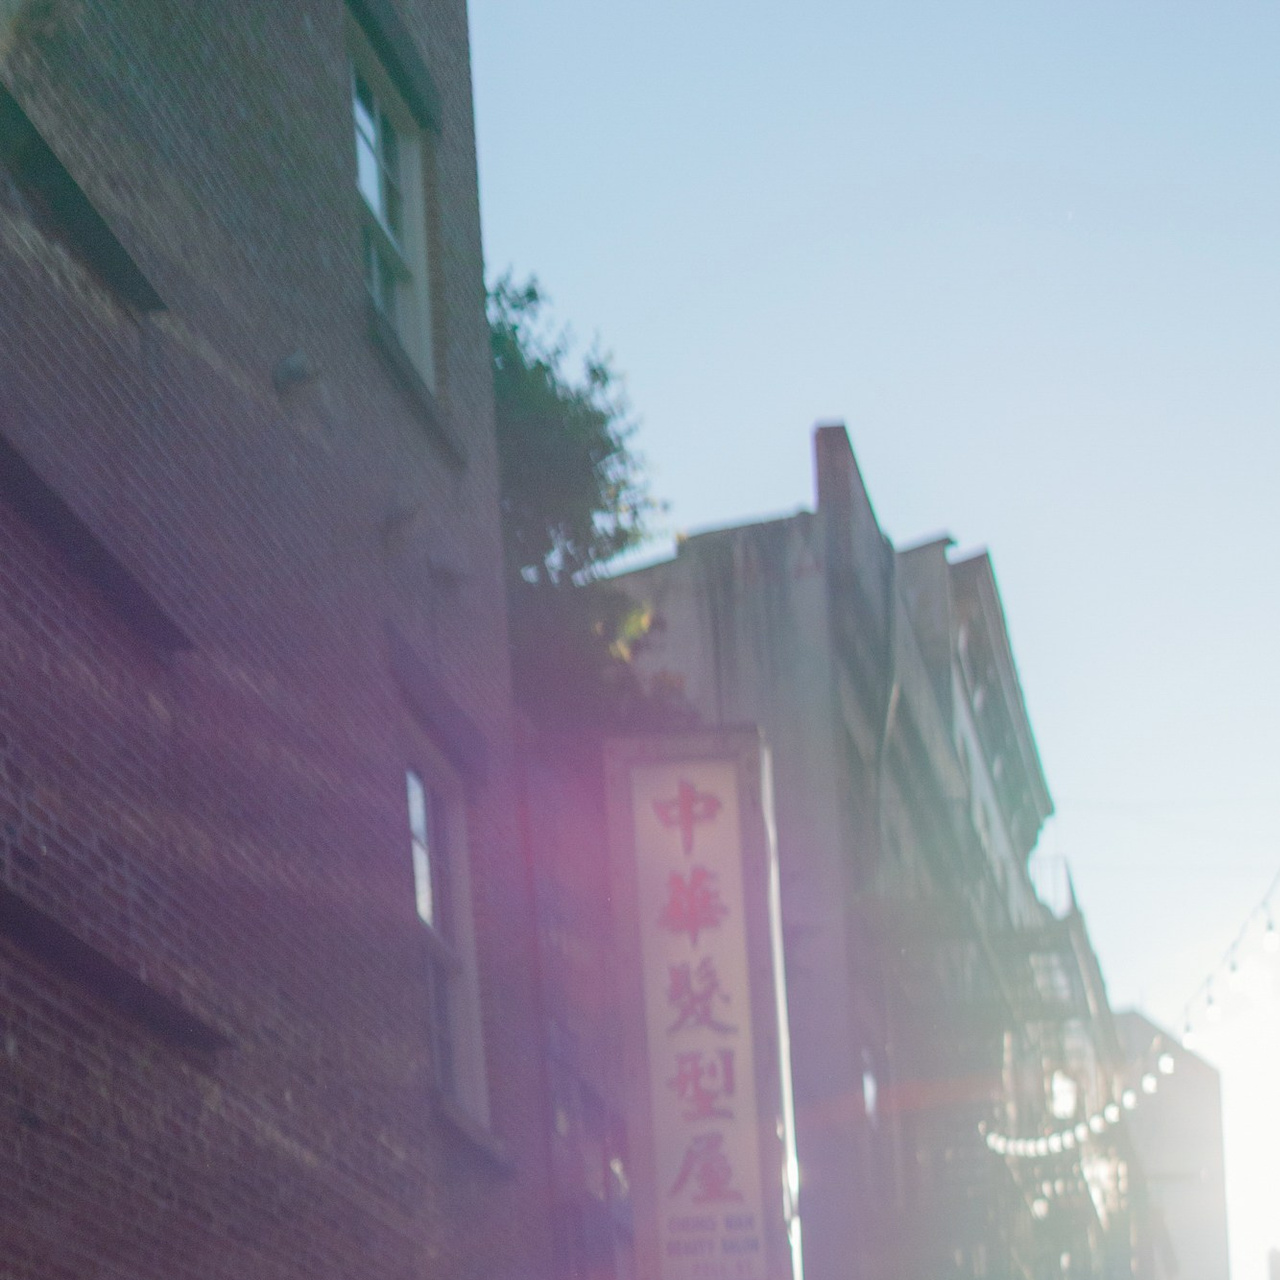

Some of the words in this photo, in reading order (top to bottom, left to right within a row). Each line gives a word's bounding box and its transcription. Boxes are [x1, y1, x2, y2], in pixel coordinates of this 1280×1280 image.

[651, 775, 745, 1204] 中華髮型屋
